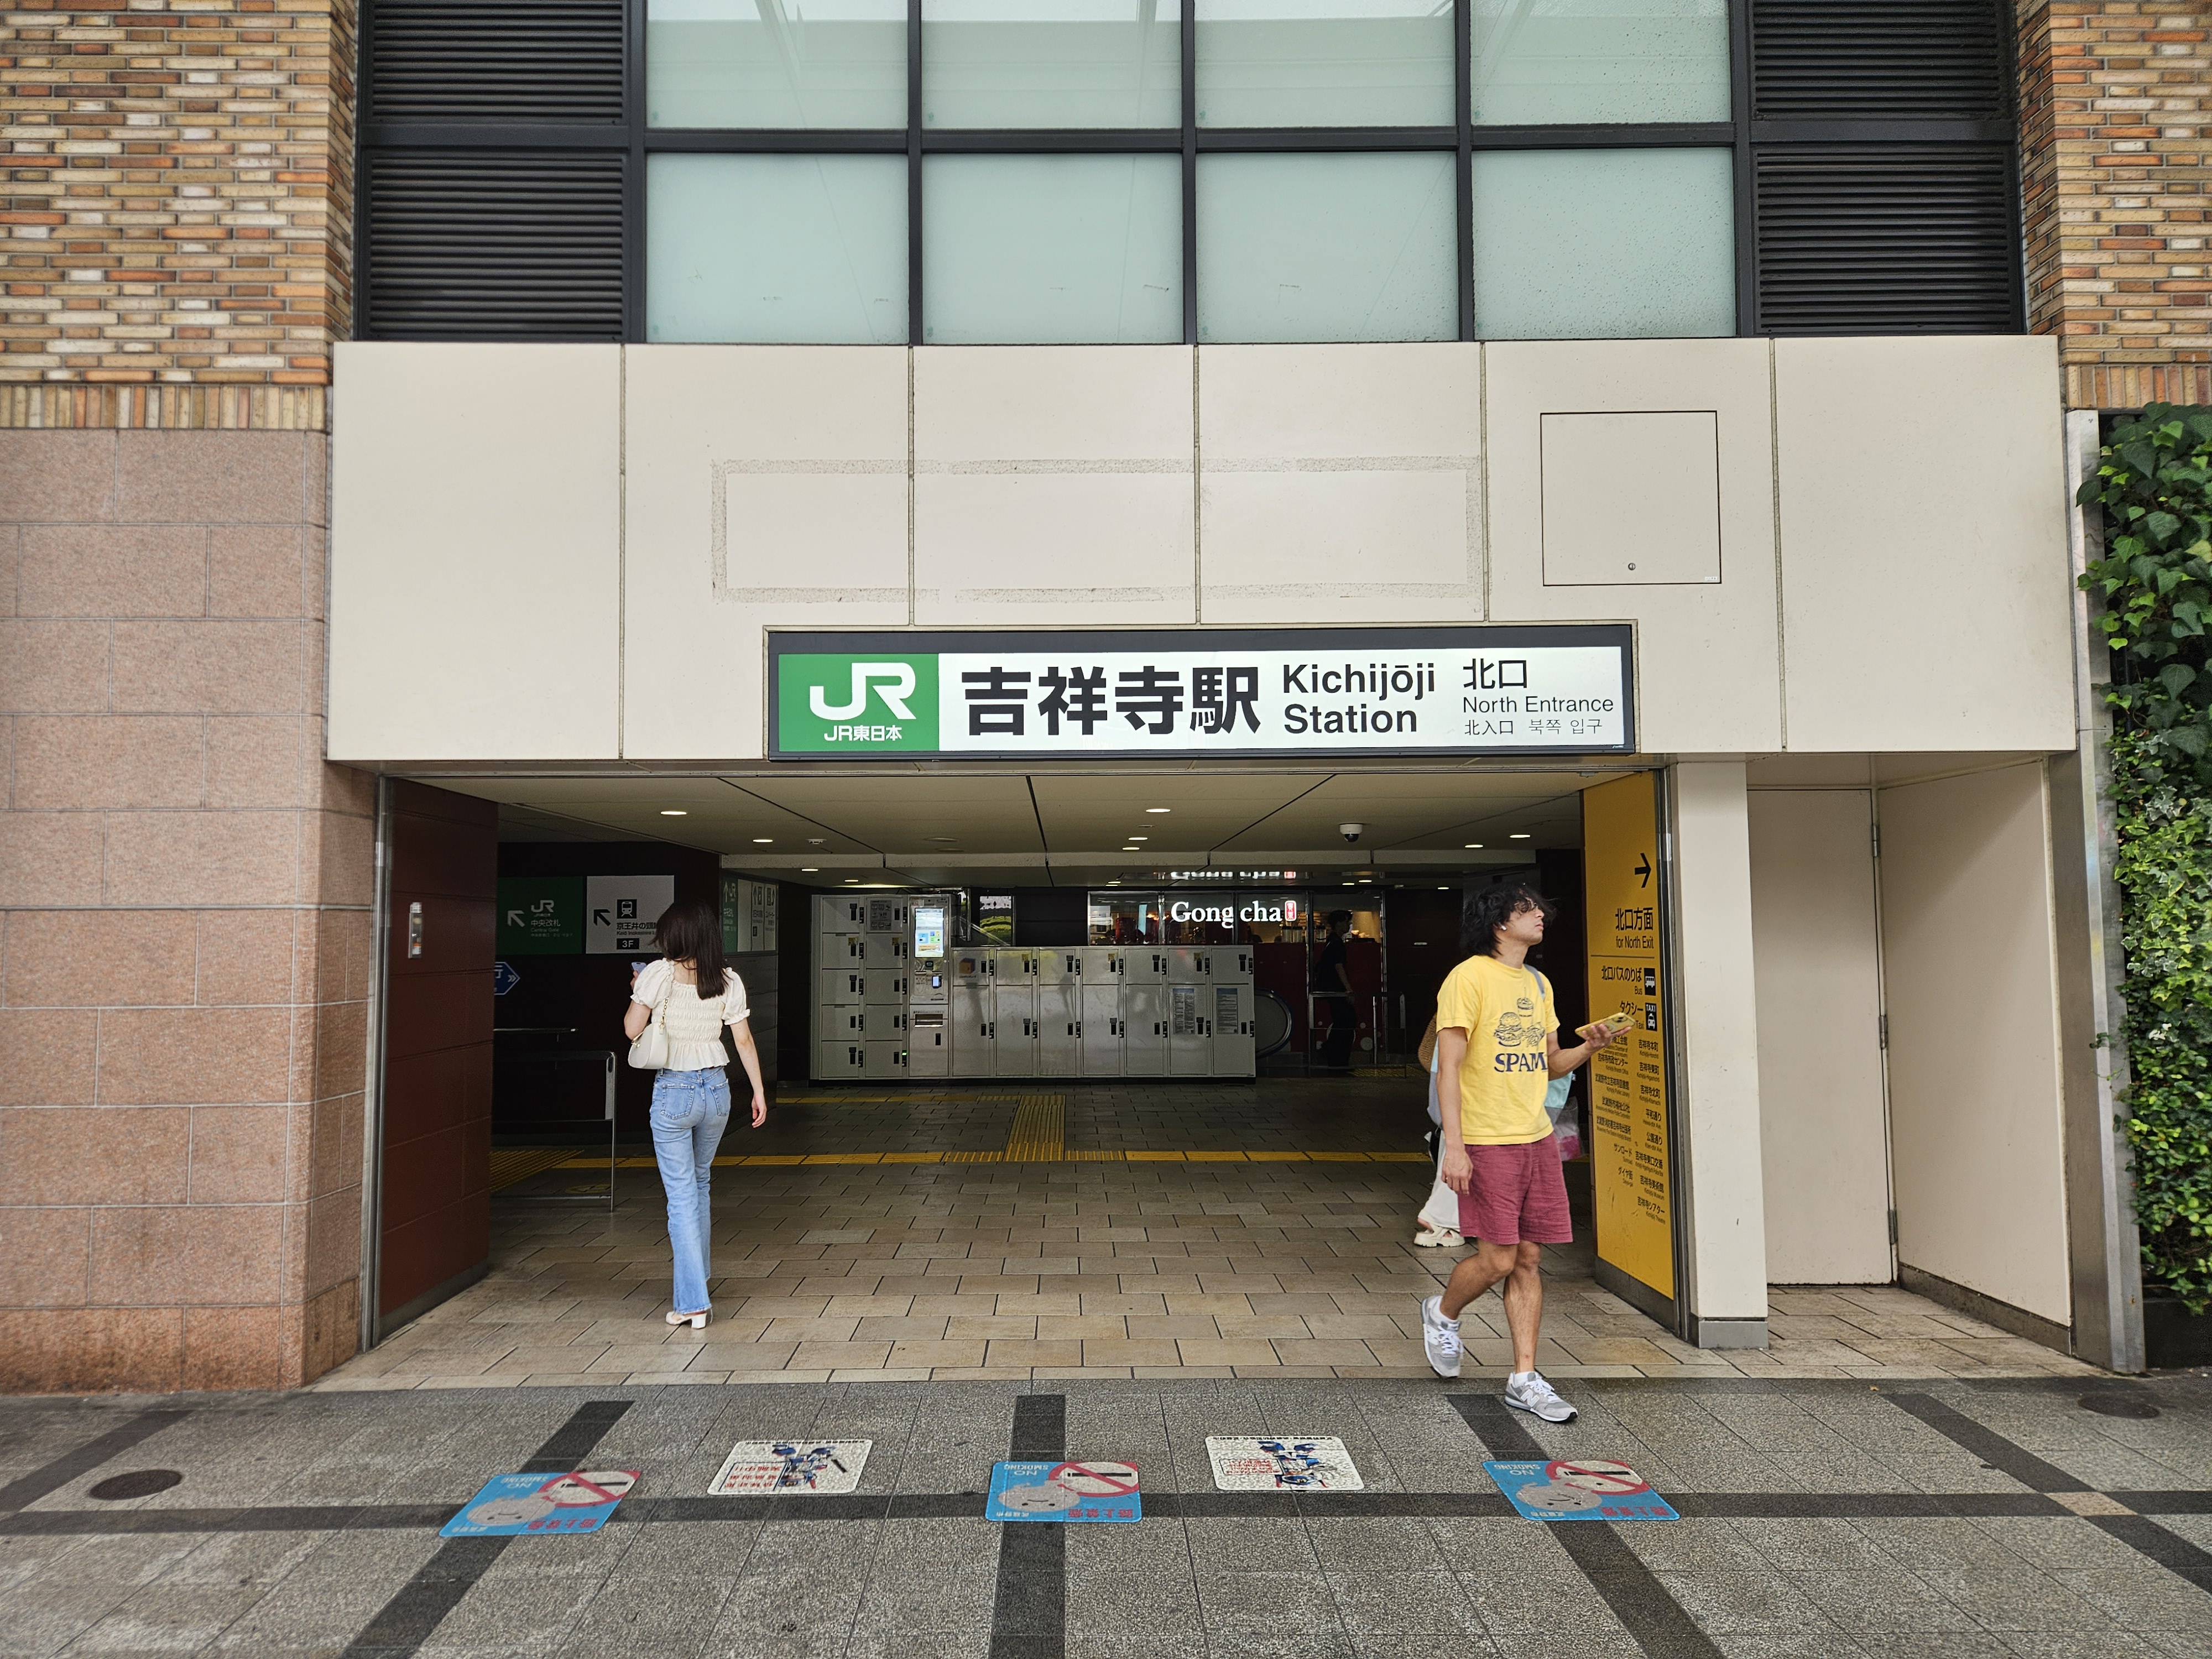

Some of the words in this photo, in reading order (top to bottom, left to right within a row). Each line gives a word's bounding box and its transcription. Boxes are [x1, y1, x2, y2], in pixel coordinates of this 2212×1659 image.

[1283, 662, 1434, 701] Kichijōji
[1463, 658, 1528, 690] 北口
[810, 662, 917, 721] JR
[961, 665, 1261, 737] 吉祥寺駅
[1463, 696, 1517, 713] North
[1525, 696, 1614, 712] Entrance
[1284, 703, 1417, 734] Station
[1528, 719, 1562, 735] 북쪽
[1570, 718, 1603, 734] 입구
[823, 724, 902, 742] JR東日本
[1464, 719, 1514, 736] 北入口
[531, 900, 554, 912] JR
[530, 919, 561, 927] 中央改札
[1171, 901, 1234, 930] Gong
[1240, 900, 1283, 923] cha
[1615, 907, 1653, 931] 北口方面
[1625, 936, 1641, 948] North
[1642, 936, 1654, 949] Exit
[1601, 966, 1642, 982] 北口バスのりば
[1634, 985, 1642, 995] Bus
[1620, 1000, 1644, 1015] タクシー
[1646, 1004, 1656, 1013] TAXI
[1635, 1020, 1645, 1030] Taxi
[1494, 1052, 1548, 1073] SPAM
